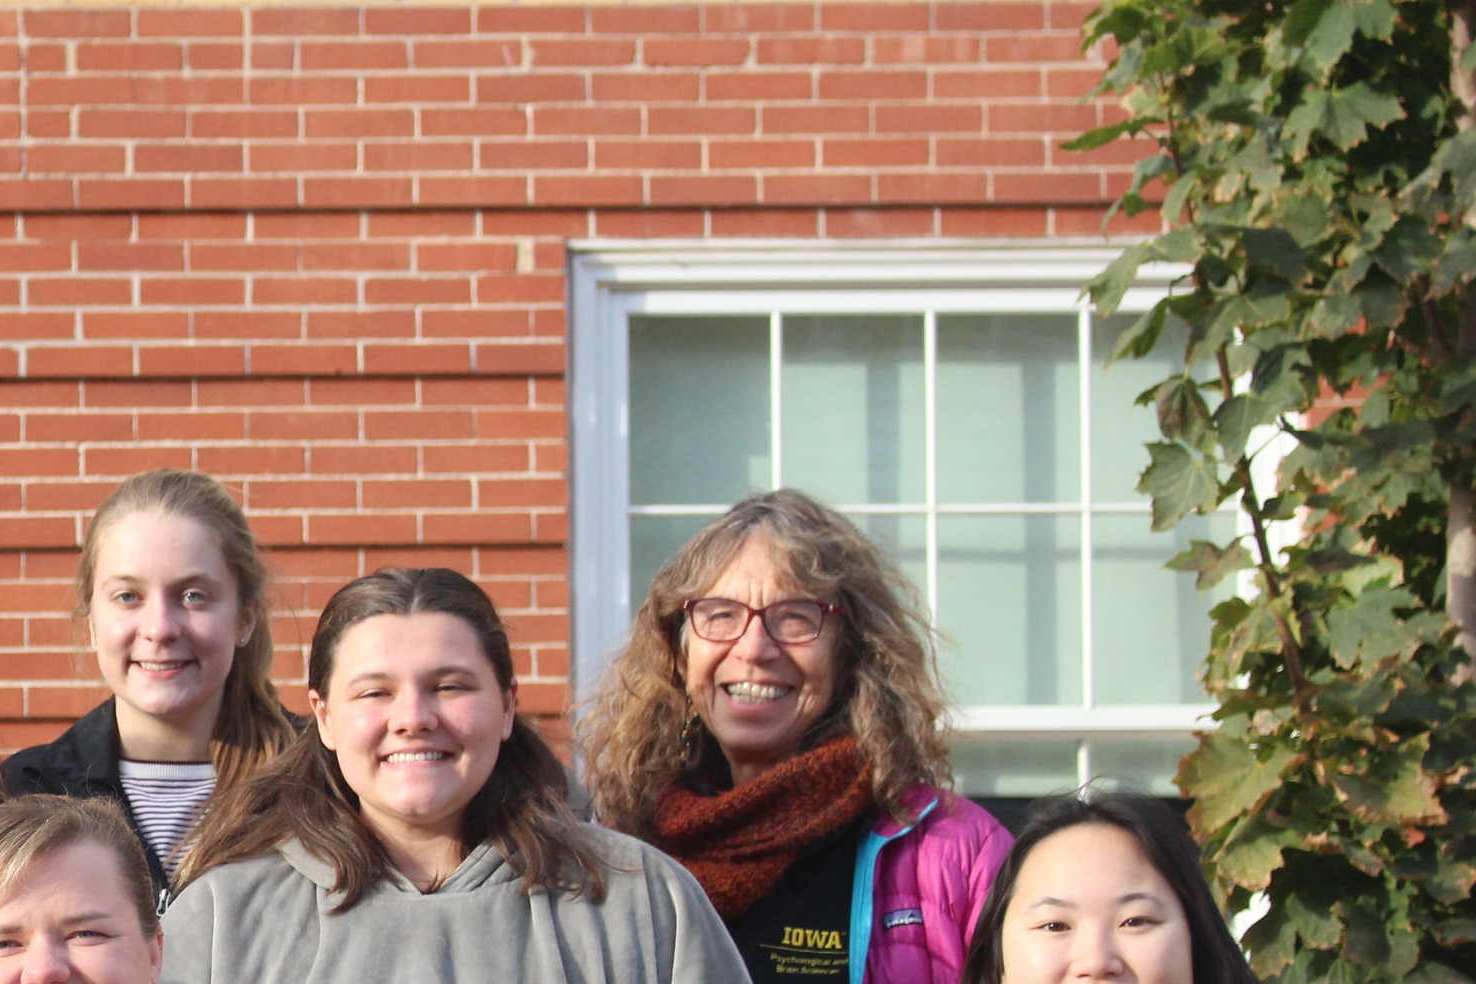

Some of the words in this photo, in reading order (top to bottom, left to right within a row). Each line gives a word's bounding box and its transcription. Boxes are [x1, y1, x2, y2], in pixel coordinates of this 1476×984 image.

[781, 926, 842, 949] IOWA
[770, 952, 831, 967] Psychological
[776, 964, 799, 974] Brain
